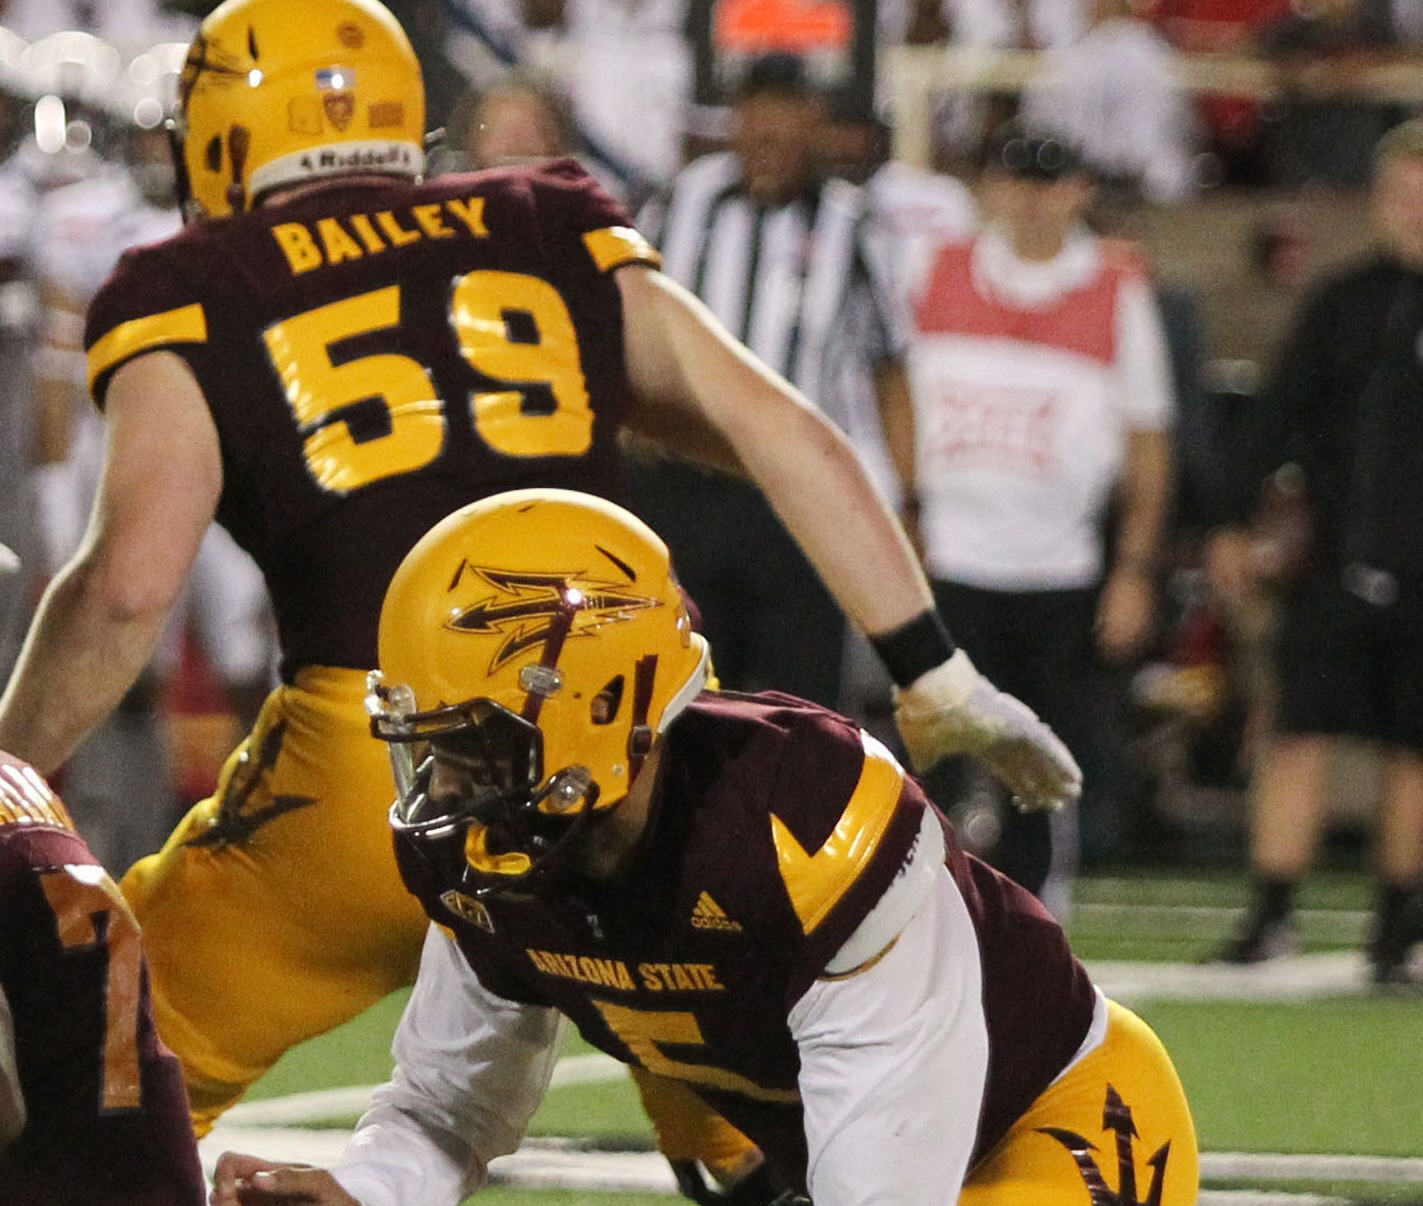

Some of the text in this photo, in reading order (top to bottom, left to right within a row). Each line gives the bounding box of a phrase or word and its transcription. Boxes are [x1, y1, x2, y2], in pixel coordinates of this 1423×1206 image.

[271, 197, 492, 276] BAILEY
[264, 269, 595, 495] 59
[39, 864, 143, 1109] 7
[526, 948, 726, 991] ARIZONA STATE
